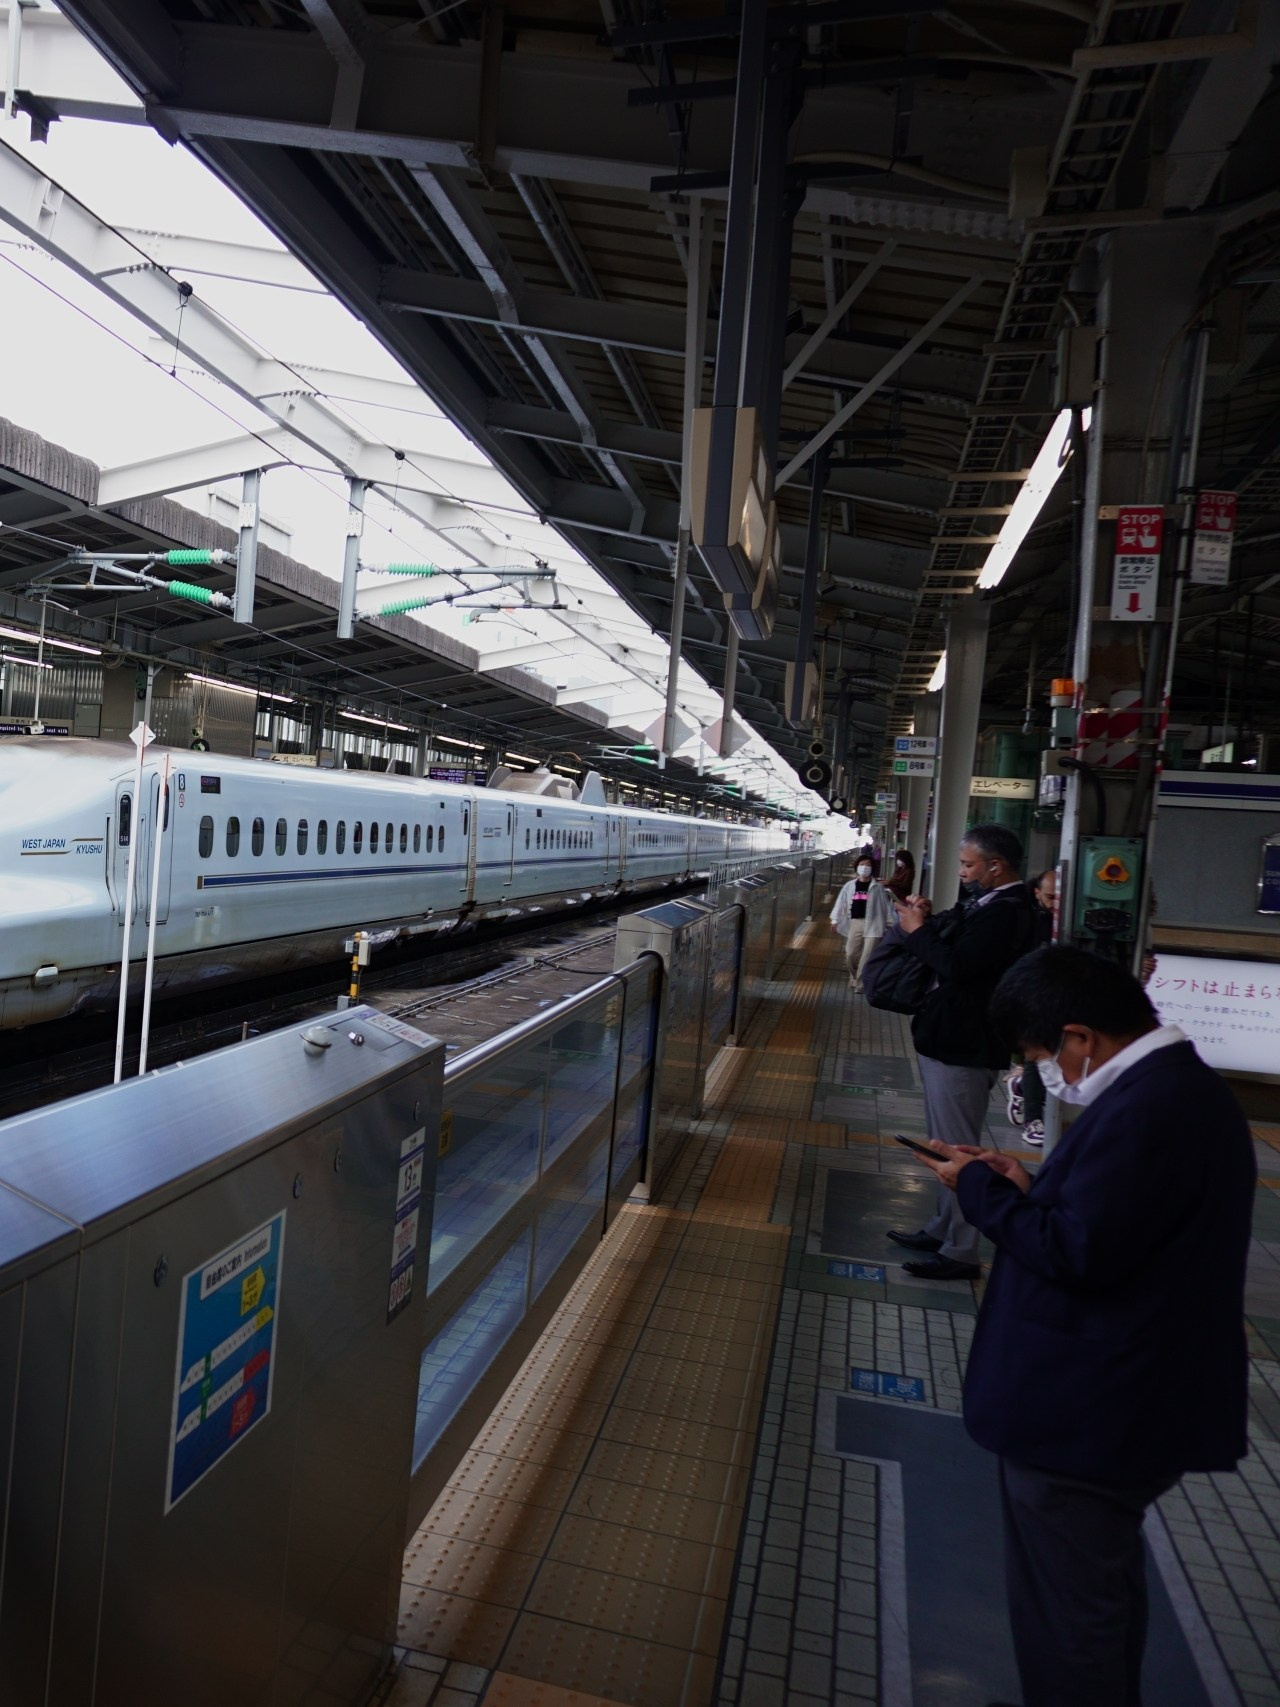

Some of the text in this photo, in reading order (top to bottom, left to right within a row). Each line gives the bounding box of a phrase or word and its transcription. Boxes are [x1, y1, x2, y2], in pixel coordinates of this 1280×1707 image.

[1200, 494, 1236, 506] STOP
[1121, 514, 1160, 525] STOP
[1120, 566, 1154, 574] ボタン
[910, 740, 927, 748] 12号車
[909, 761, 925, 770] 8号車
[973, 780, 1030, 790] エレベーター
[22, 839, 66, 849] WEST JAPAN
[76, 844, 103, 854] KYUSHU
